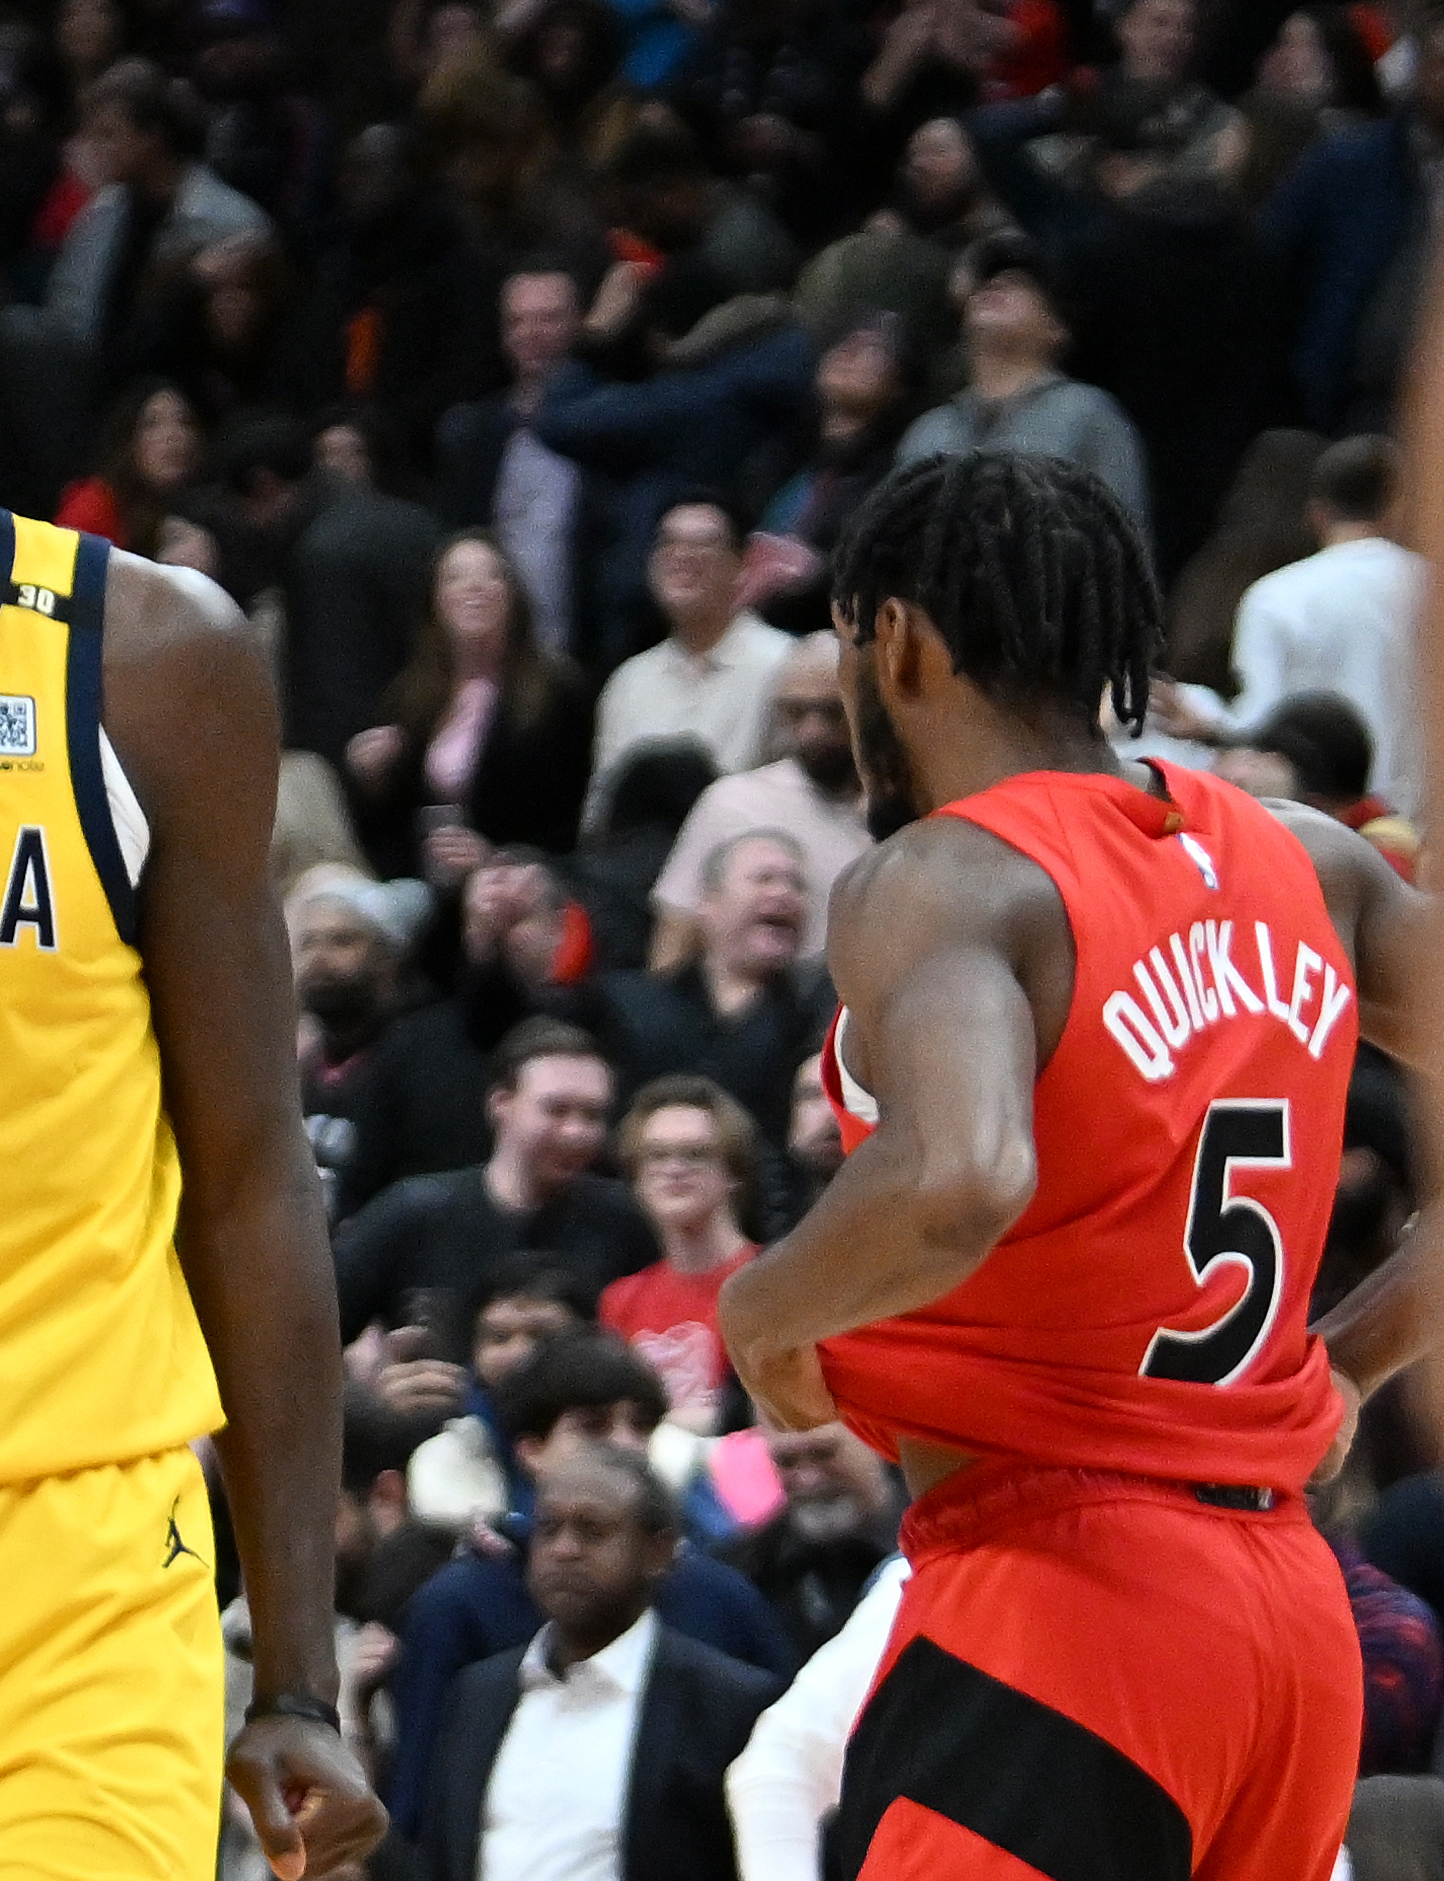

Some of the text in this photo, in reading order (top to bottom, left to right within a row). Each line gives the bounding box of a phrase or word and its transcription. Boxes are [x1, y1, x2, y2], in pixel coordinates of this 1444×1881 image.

[17, 585, 55, 616] 30
[1103, 918, 1351, 1083] QUICKLEY
[1138, 1098, 1292, 1386] 5
